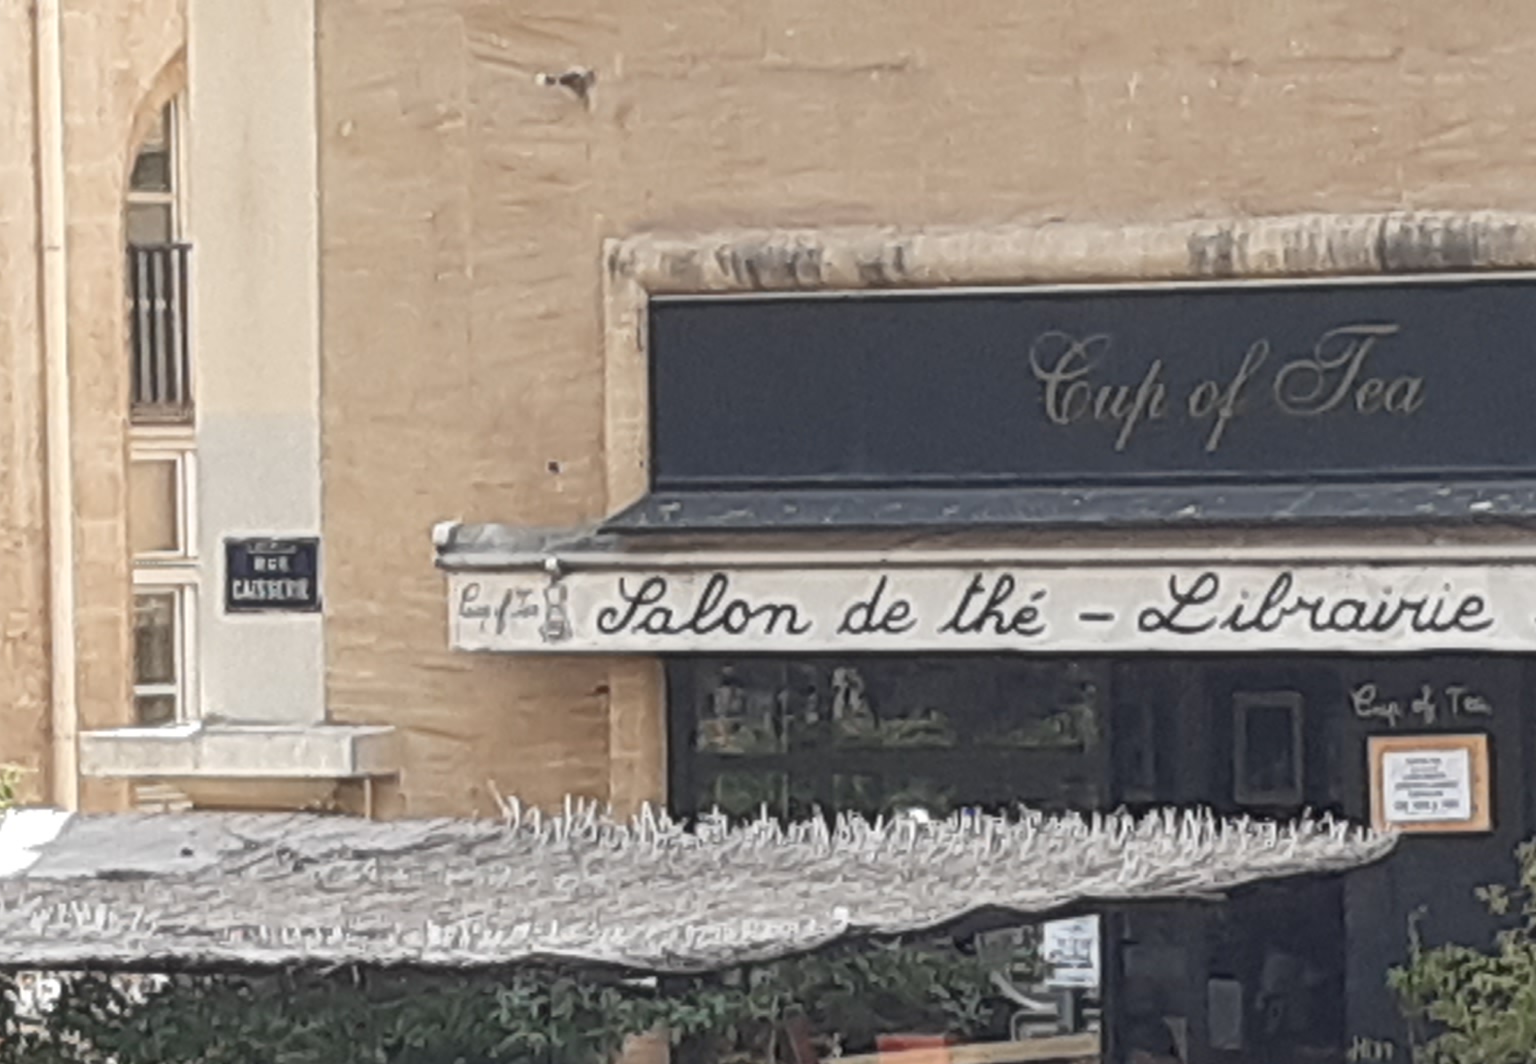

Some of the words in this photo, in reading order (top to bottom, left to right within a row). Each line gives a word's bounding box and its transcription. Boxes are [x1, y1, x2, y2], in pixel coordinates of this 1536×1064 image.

[1030, 331, 1164, 452] Cup
[1188, 338, 1269, 452] of
[1273, 324, 1425, 416] Tea
[253, 555, 290, 573] RUE
[597, 572, 812, 635] Salon
[836, 574, 917, 635] de
[937, 572, 1047, 636] thé
[1138, 571, 1494, 635] Librairie
[1350, 684, 1402, 728] Cup
